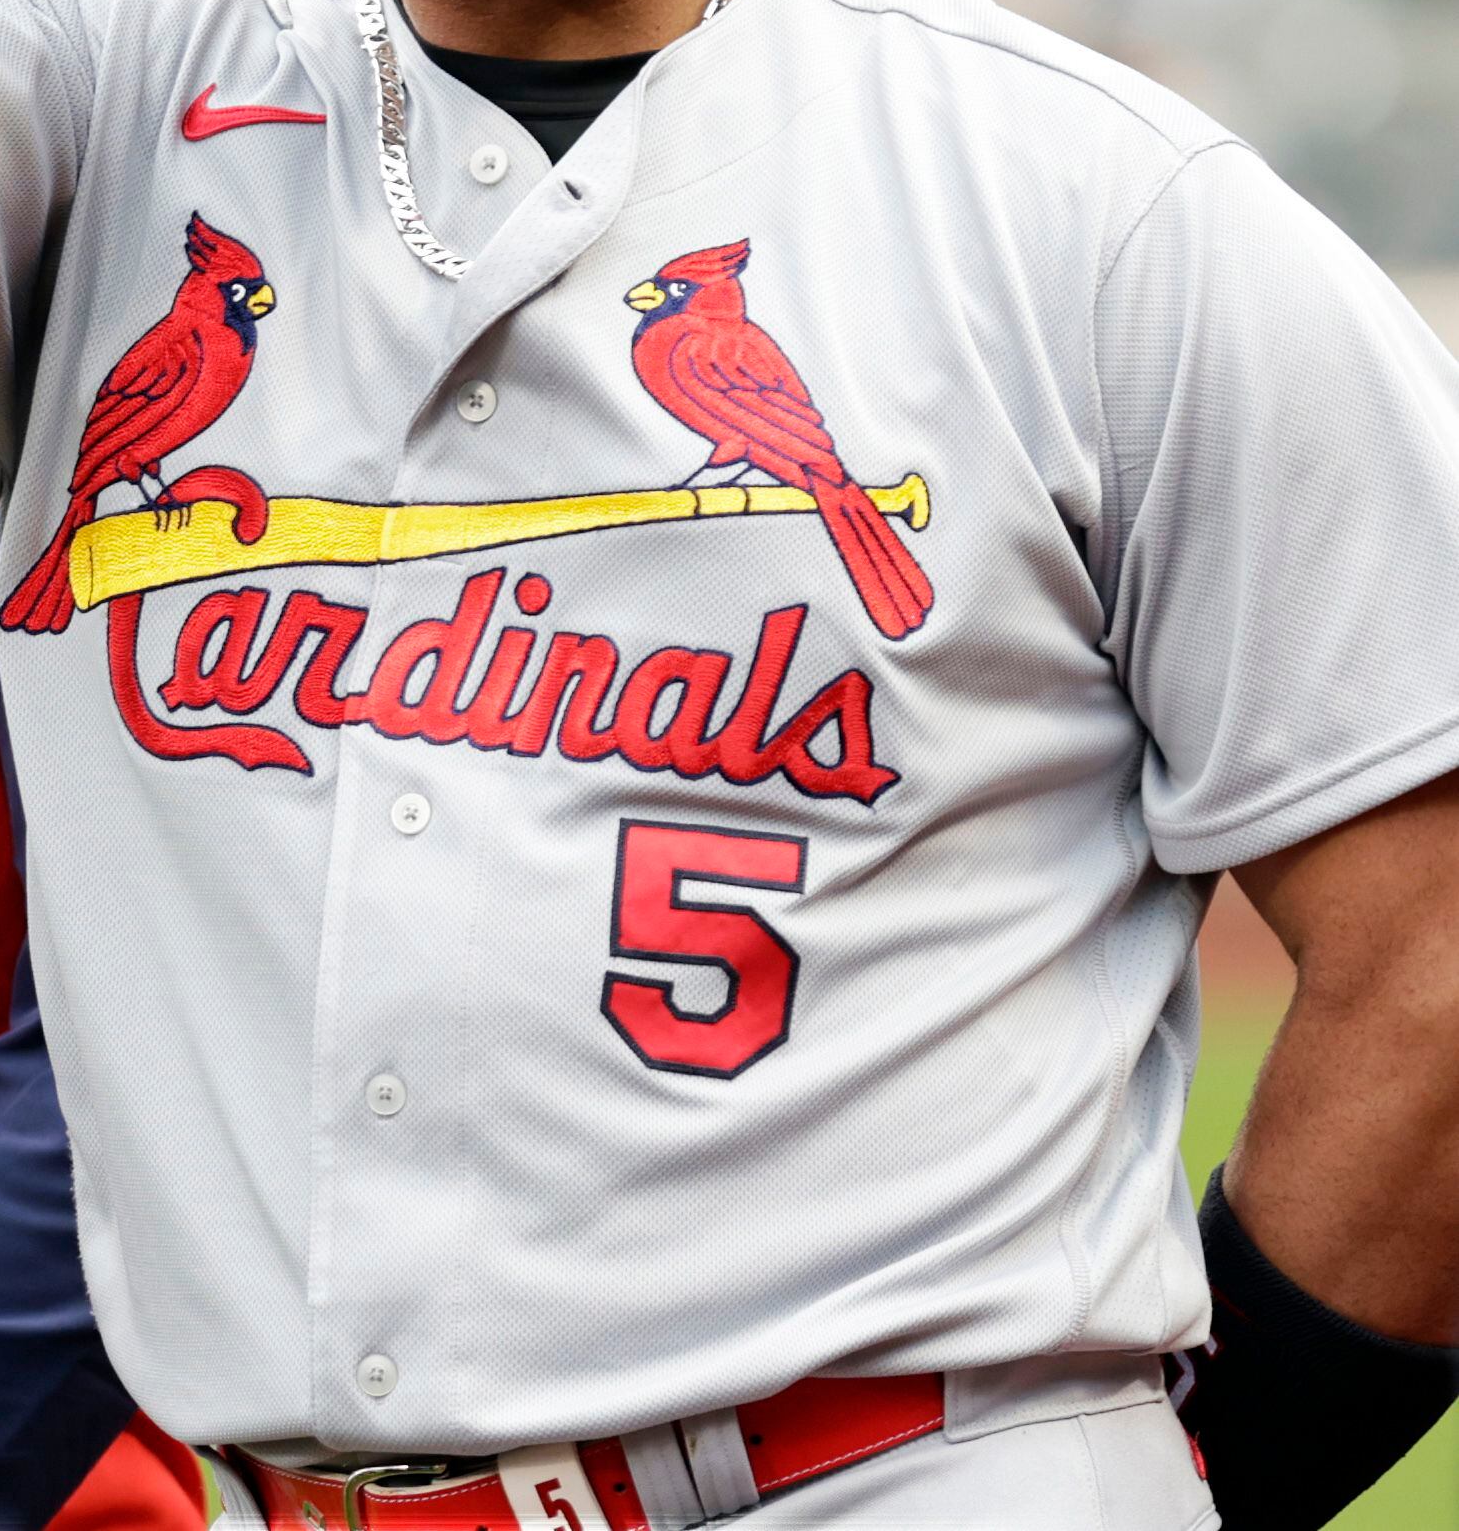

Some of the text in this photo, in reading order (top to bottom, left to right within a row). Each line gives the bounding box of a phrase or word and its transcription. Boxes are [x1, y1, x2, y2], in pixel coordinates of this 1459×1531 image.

[106, 466, 901, 805] Cardinals
[601, 817, 808, 1079] 5
[534, 1477, 583, 1531] 5
